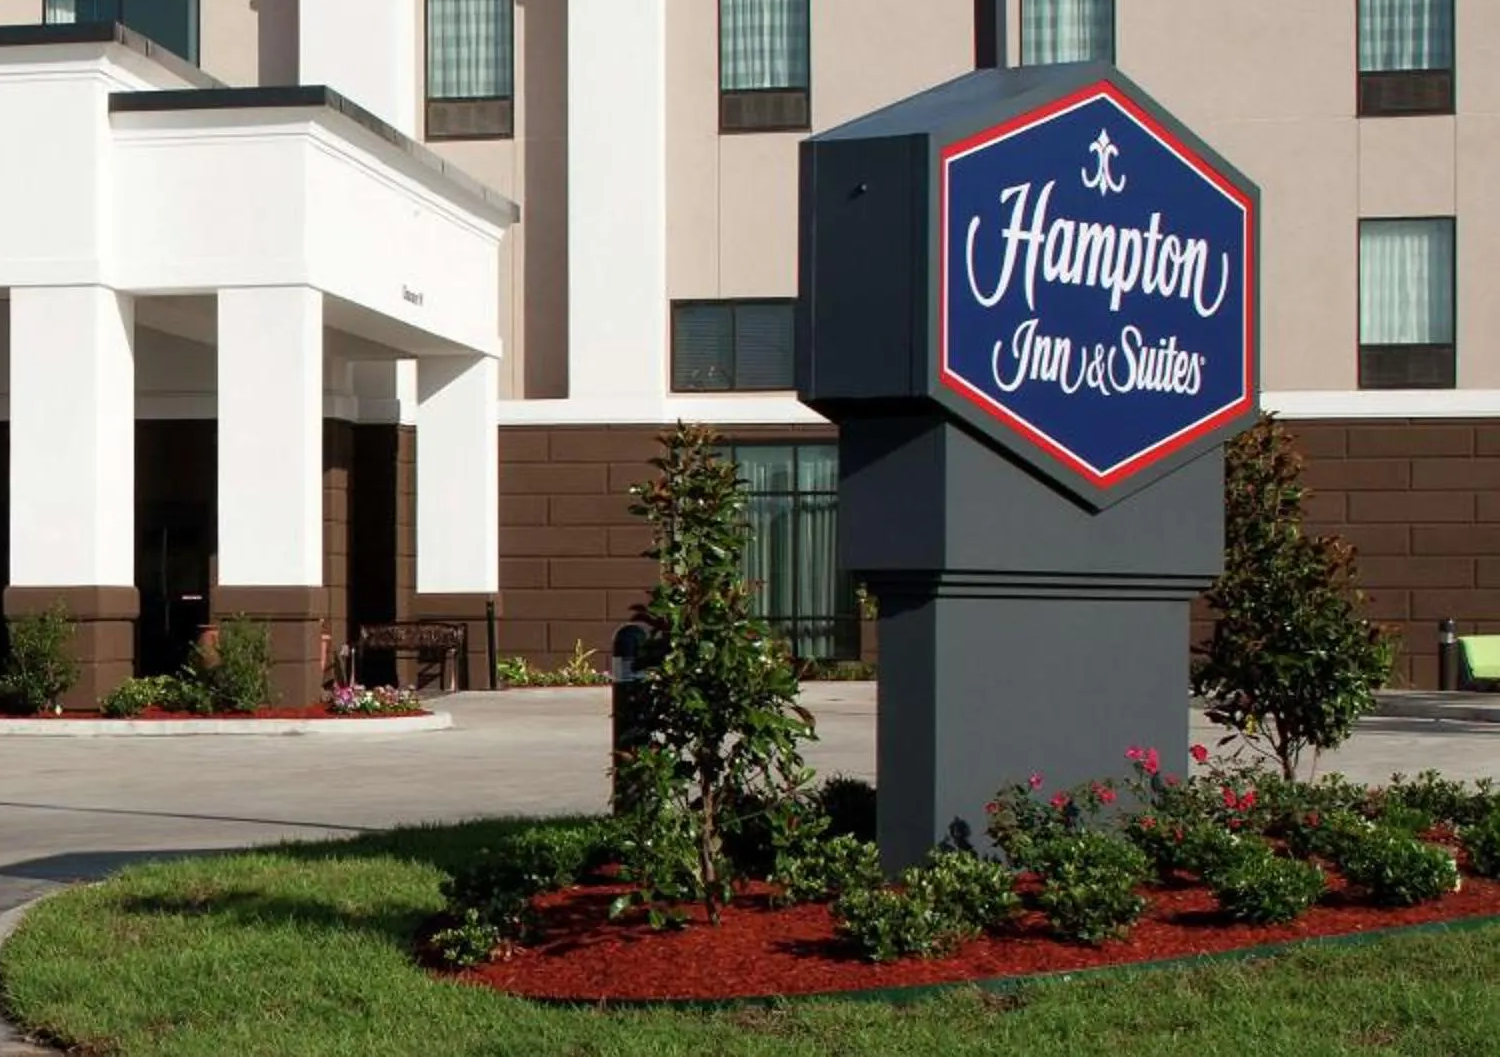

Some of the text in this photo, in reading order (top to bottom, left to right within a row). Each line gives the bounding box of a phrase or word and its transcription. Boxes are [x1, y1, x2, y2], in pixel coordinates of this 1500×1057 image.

[965, 179, 1229, 318] Hampton
[991, 317, 1202, 396] Inn & Suites
